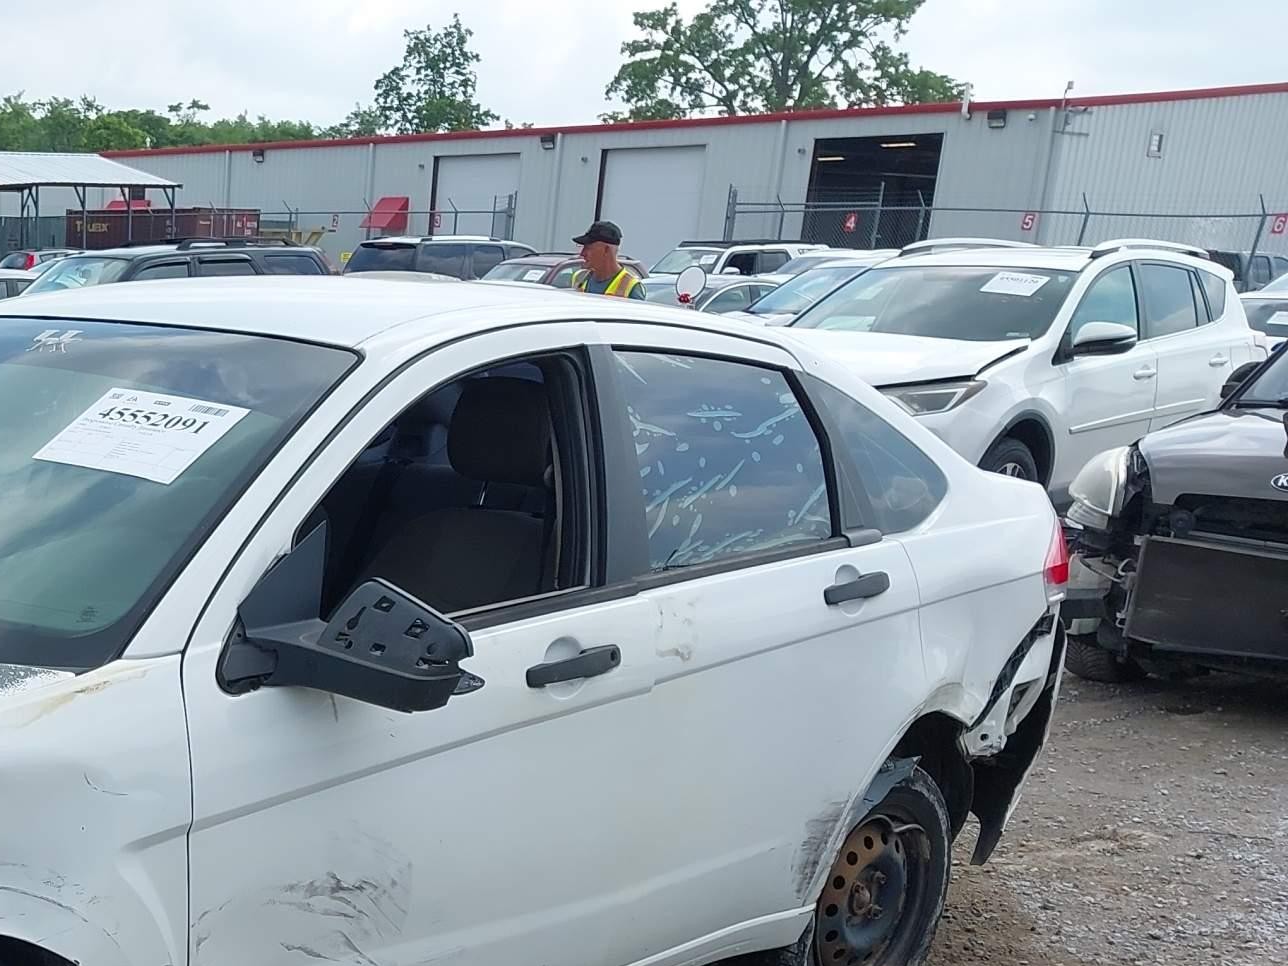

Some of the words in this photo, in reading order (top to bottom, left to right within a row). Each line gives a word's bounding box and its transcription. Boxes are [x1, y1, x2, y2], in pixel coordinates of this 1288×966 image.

[1023, 215, 1034, 229] 5
[1274, 216, 1286, 232] 6
[98, 406, 210, 434] 45552091
